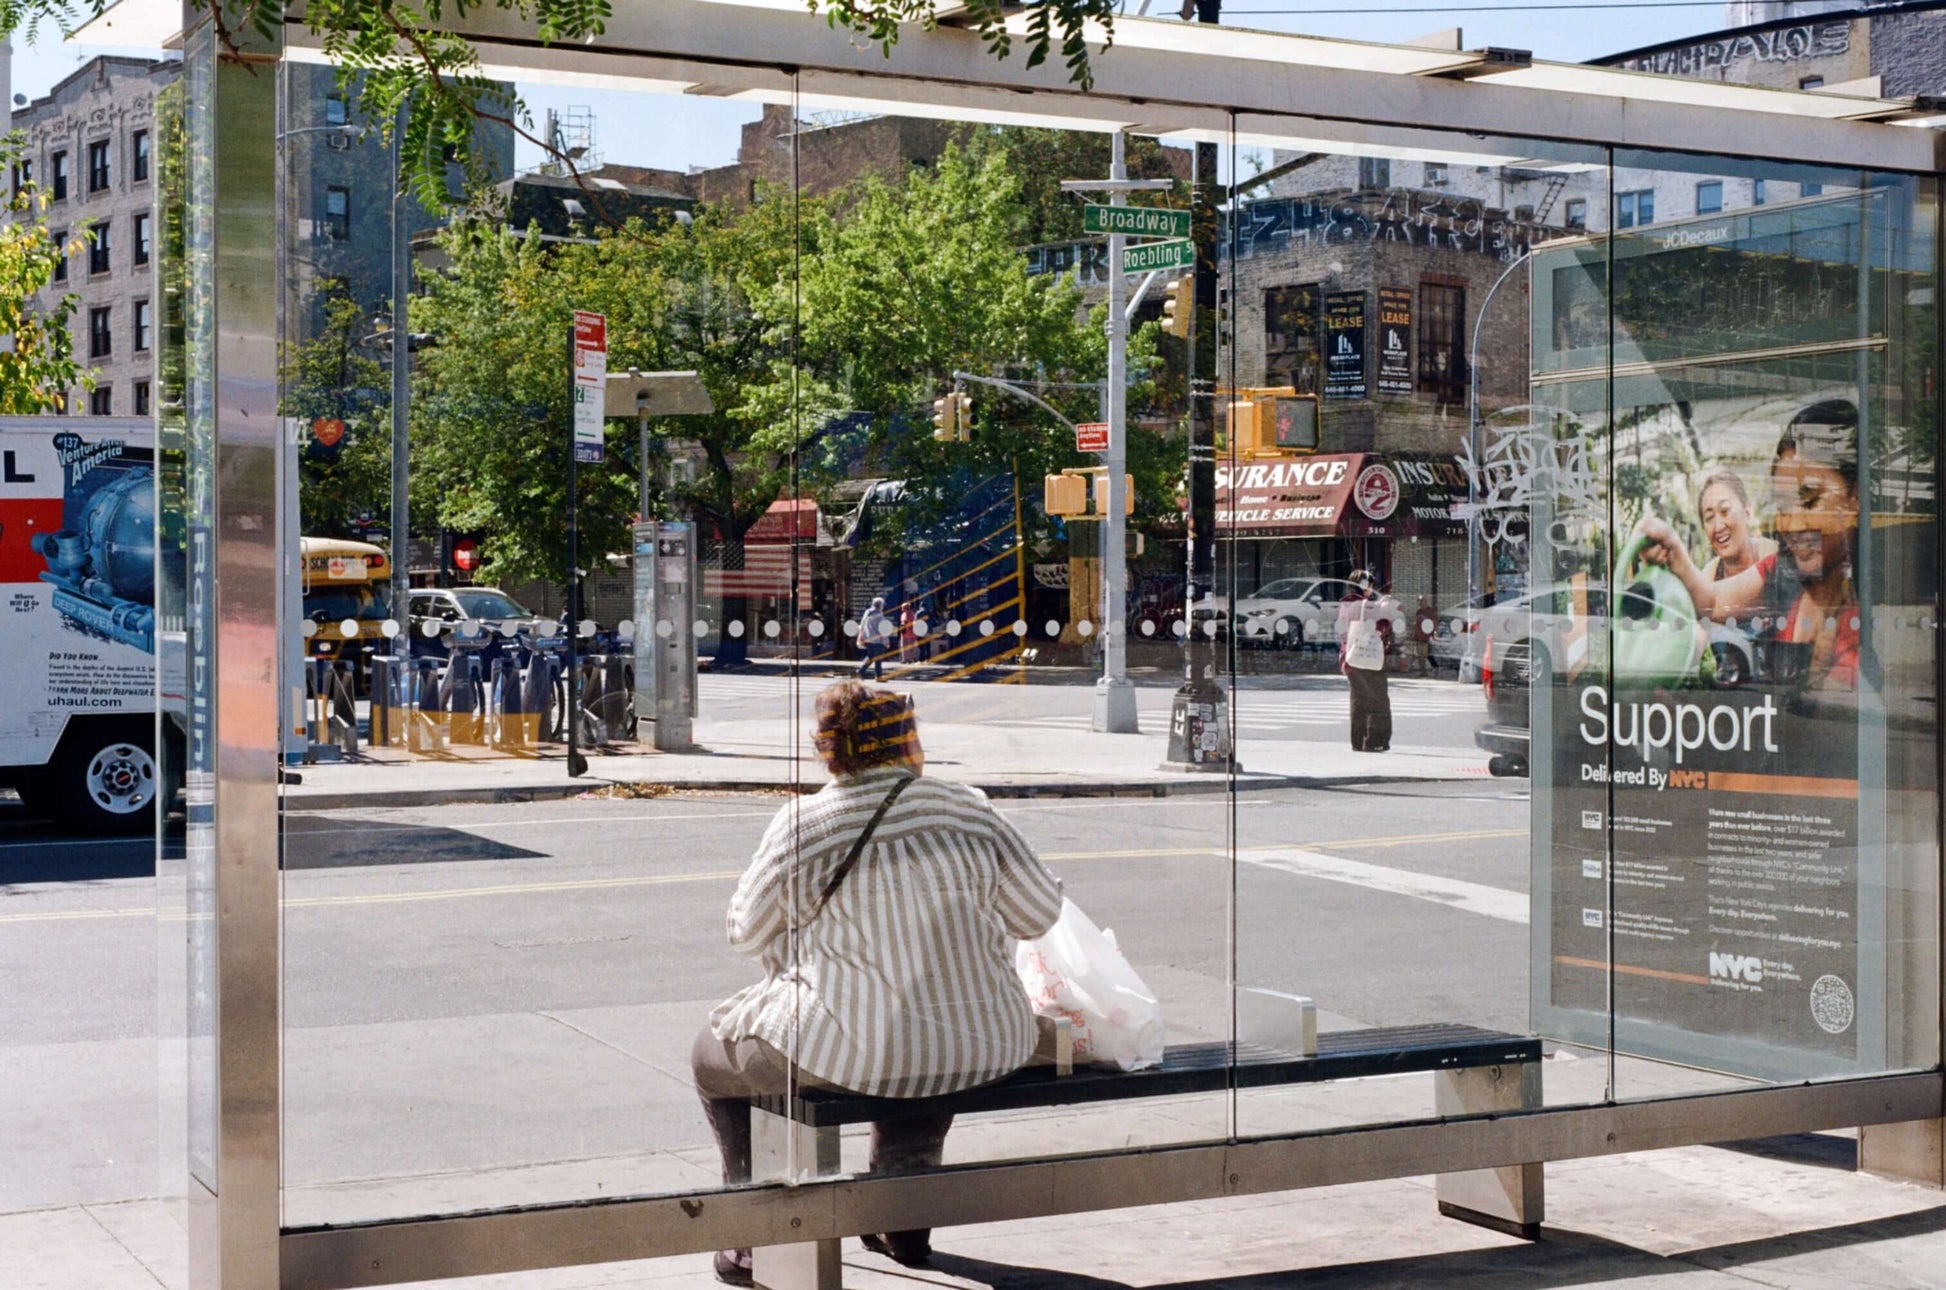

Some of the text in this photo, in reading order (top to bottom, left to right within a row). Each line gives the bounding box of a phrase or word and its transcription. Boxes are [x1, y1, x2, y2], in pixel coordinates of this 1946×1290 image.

[1099, 208, 1178, 236] Broadway
[1662, 227, 1729, 249] JCDecaux
[1124, 245, 1182, 268] Roebling
[1328, 315, 1364, 329] LEASE
[1381, 311, 1410, 325] LEASE
[58, 440, 100, 466] Venture
[72, 446, 122, 488] America
[1177, 461, 1348, 492] SURANCE
[1239, 496, 1268, 505] Home
[1272, 506, 1335, 520] SERVICE
[1411, 506, 1450, 520] MOTOR
[1367, 526, 1386, 535] 310
[79, 607, 114, 631] ROVER
[63, 652, 77, 661] YOU
[47, 696, 122, 707] uhaul.com
[1579, 685, 1779, 764] Support
[1648, 768, 1668, 791] By
[1669, 769, 1705, 789] NYC
[1708, 951, 1763, 983] NYC
